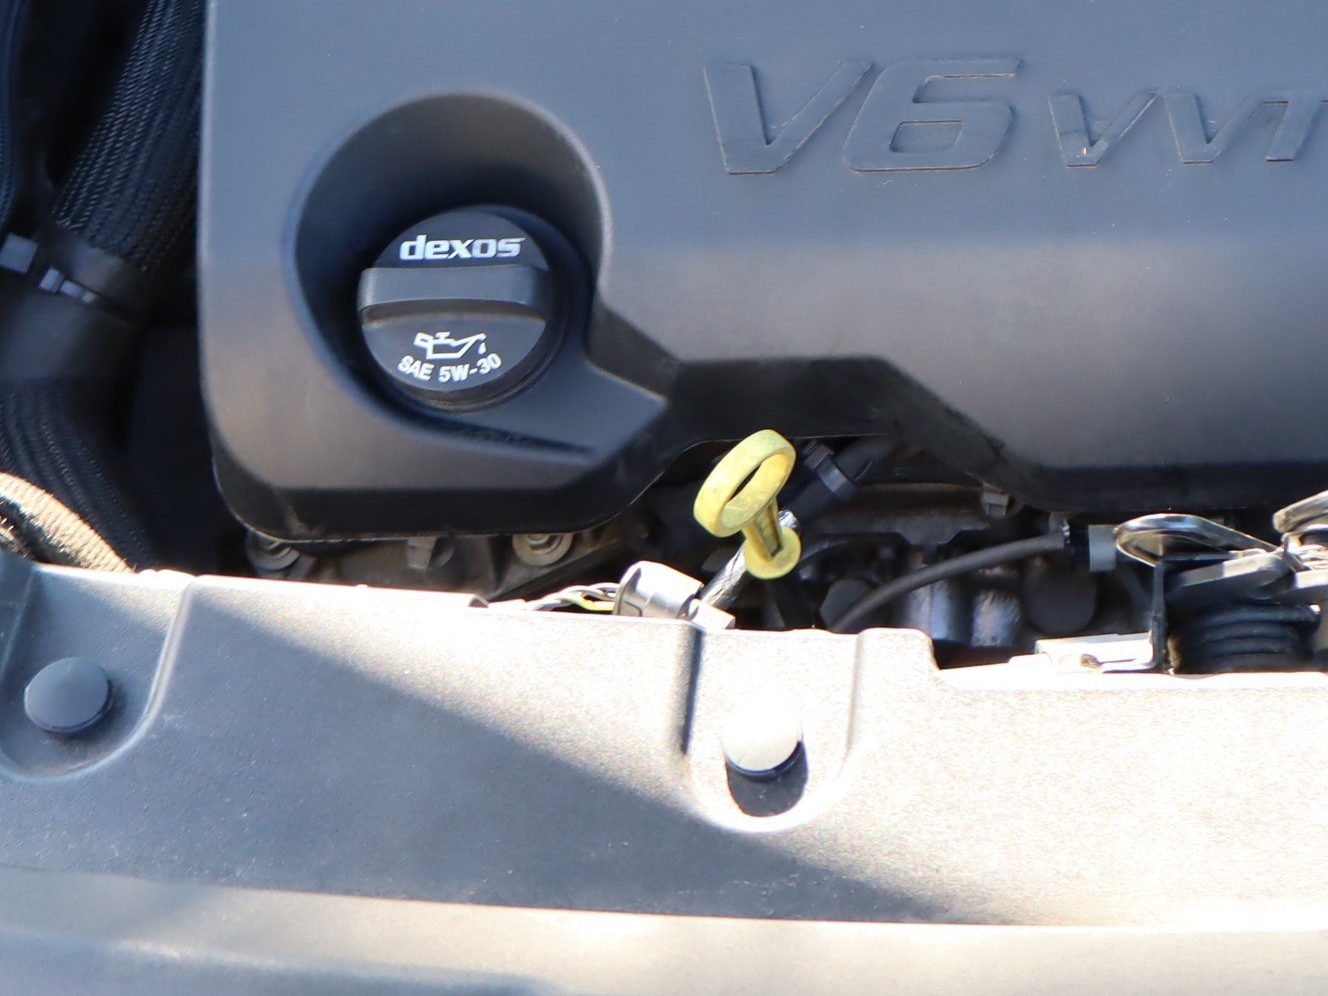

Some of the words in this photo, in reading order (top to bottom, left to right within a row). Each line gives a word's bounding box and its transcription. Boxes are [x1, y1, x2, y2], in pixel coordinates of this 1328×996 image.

[702, 57, 1023, 175] V6
[399, 234, 526, 261] dexos
[397, 355, 432, 381] SAE
[438, 353, 502, 383] 5W-30
